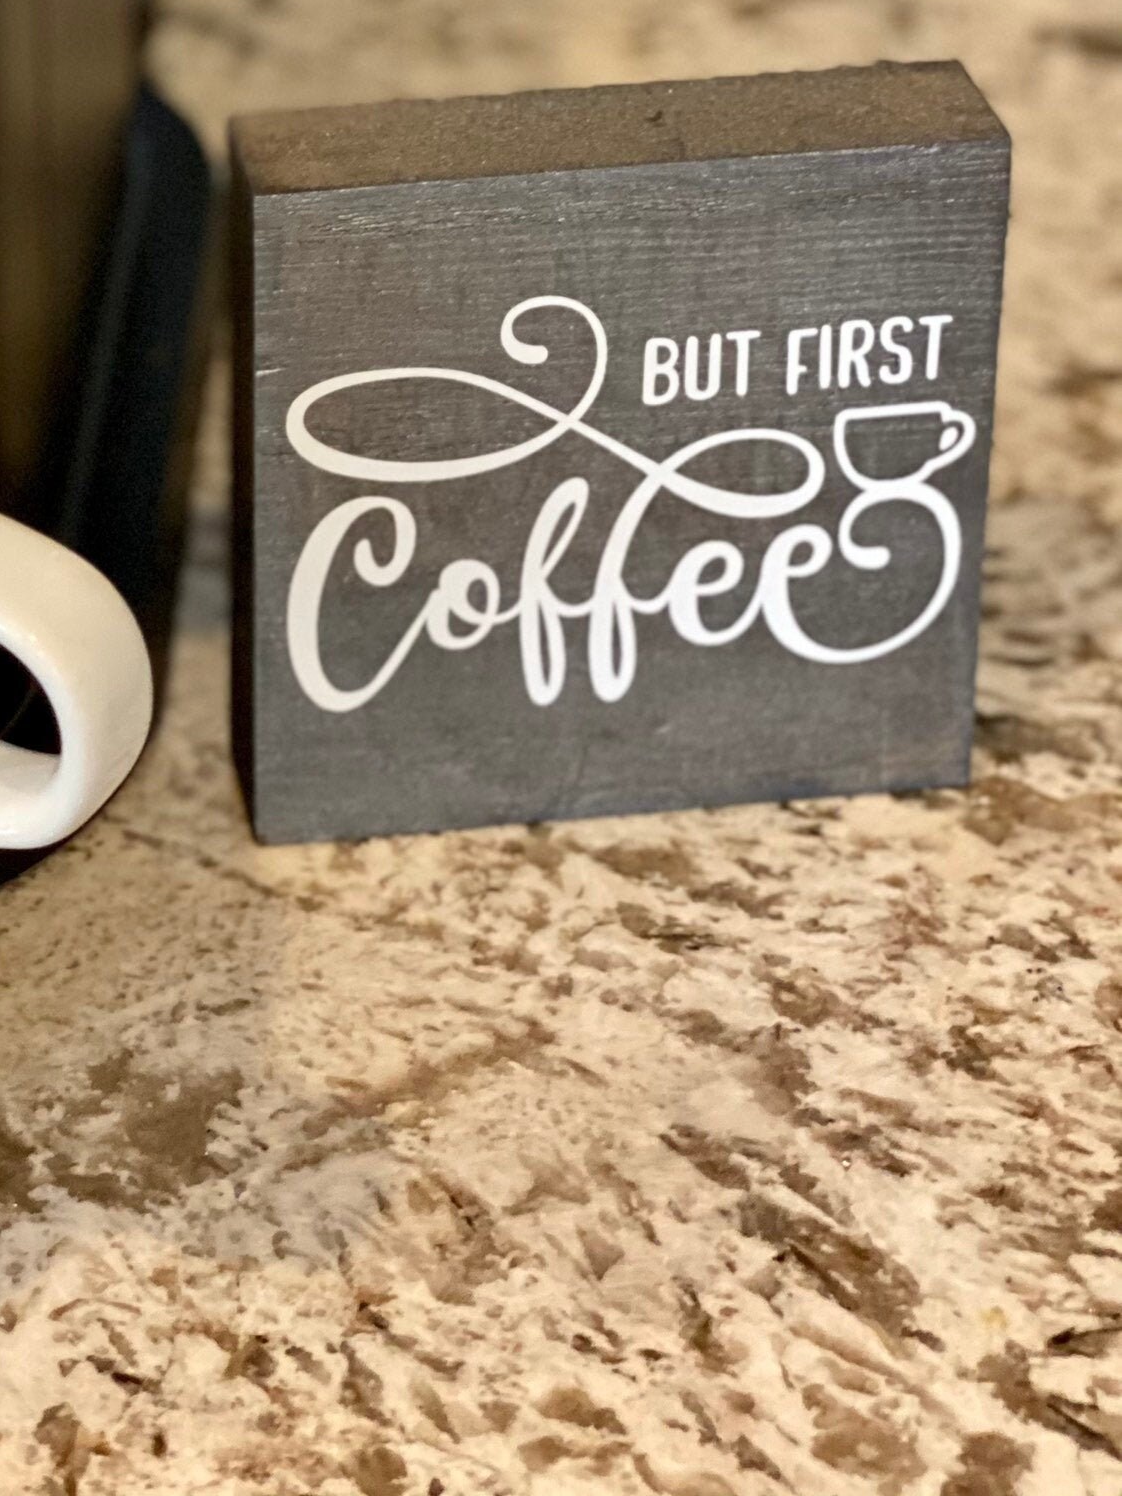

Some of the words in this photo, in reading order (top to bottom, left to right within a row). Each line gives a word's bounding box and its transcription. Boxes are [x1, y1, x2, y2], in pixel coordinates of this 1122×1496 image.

[642, 330, 761, 405] BUT
[786, 315, 953, 395] FIRST
[286, 295, 962, 713] Coffee
